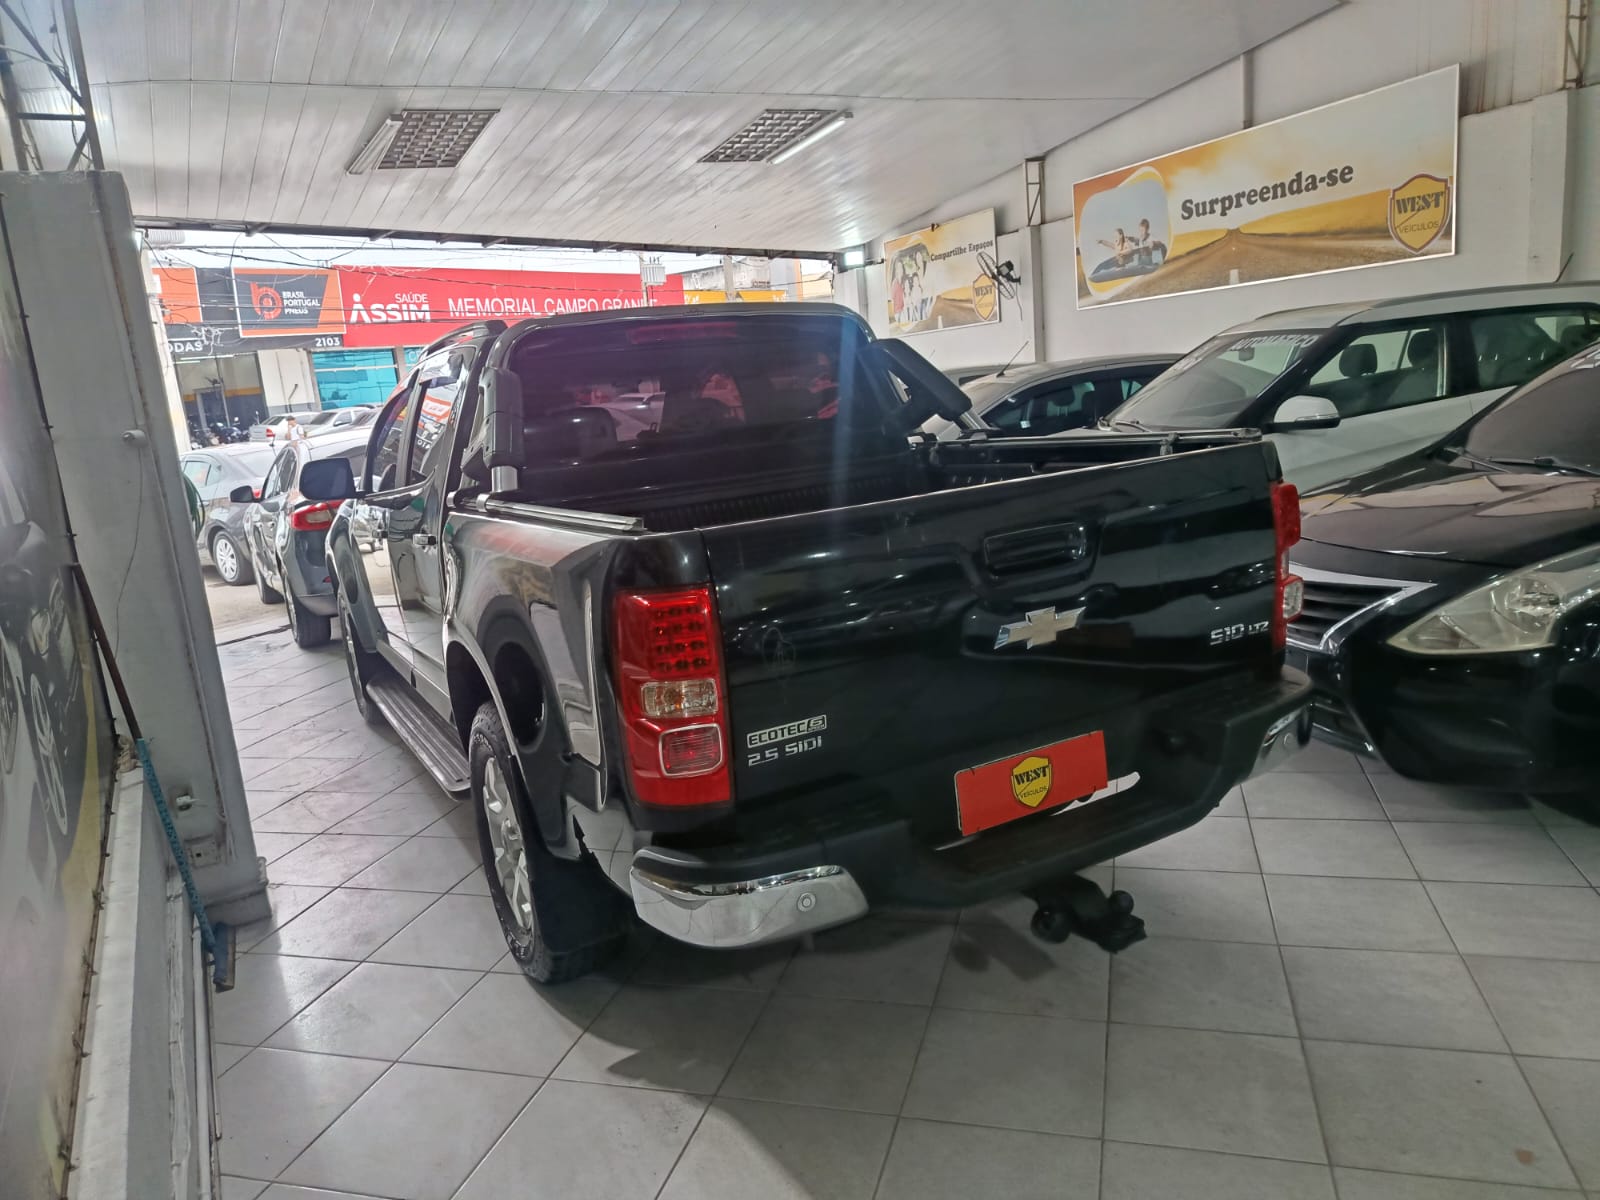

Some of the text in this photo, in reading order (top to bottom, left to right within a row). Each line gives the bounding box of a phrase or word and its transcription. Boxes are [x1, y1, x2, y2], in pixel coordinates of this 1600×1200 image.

[1180, 165, 1354, 221] Surpreenda-se
[1395, 191, 1446, 215] WEST
[282, 291, 306, 299] BRASIL
[283, 298, 321, 307] PORTUGAL
[394, 291, 429, 303] SAÚDE
[448, 297, 537, 318] MEMORIAL
[543, 298, 599, 316] CAMPO
[315, 337, 340, 347] 2103
[1210, 624, 1244, 645] S10
[749, 721, 806, 745] ECOTEC
[1014, 764, 1050, 785] WEST
